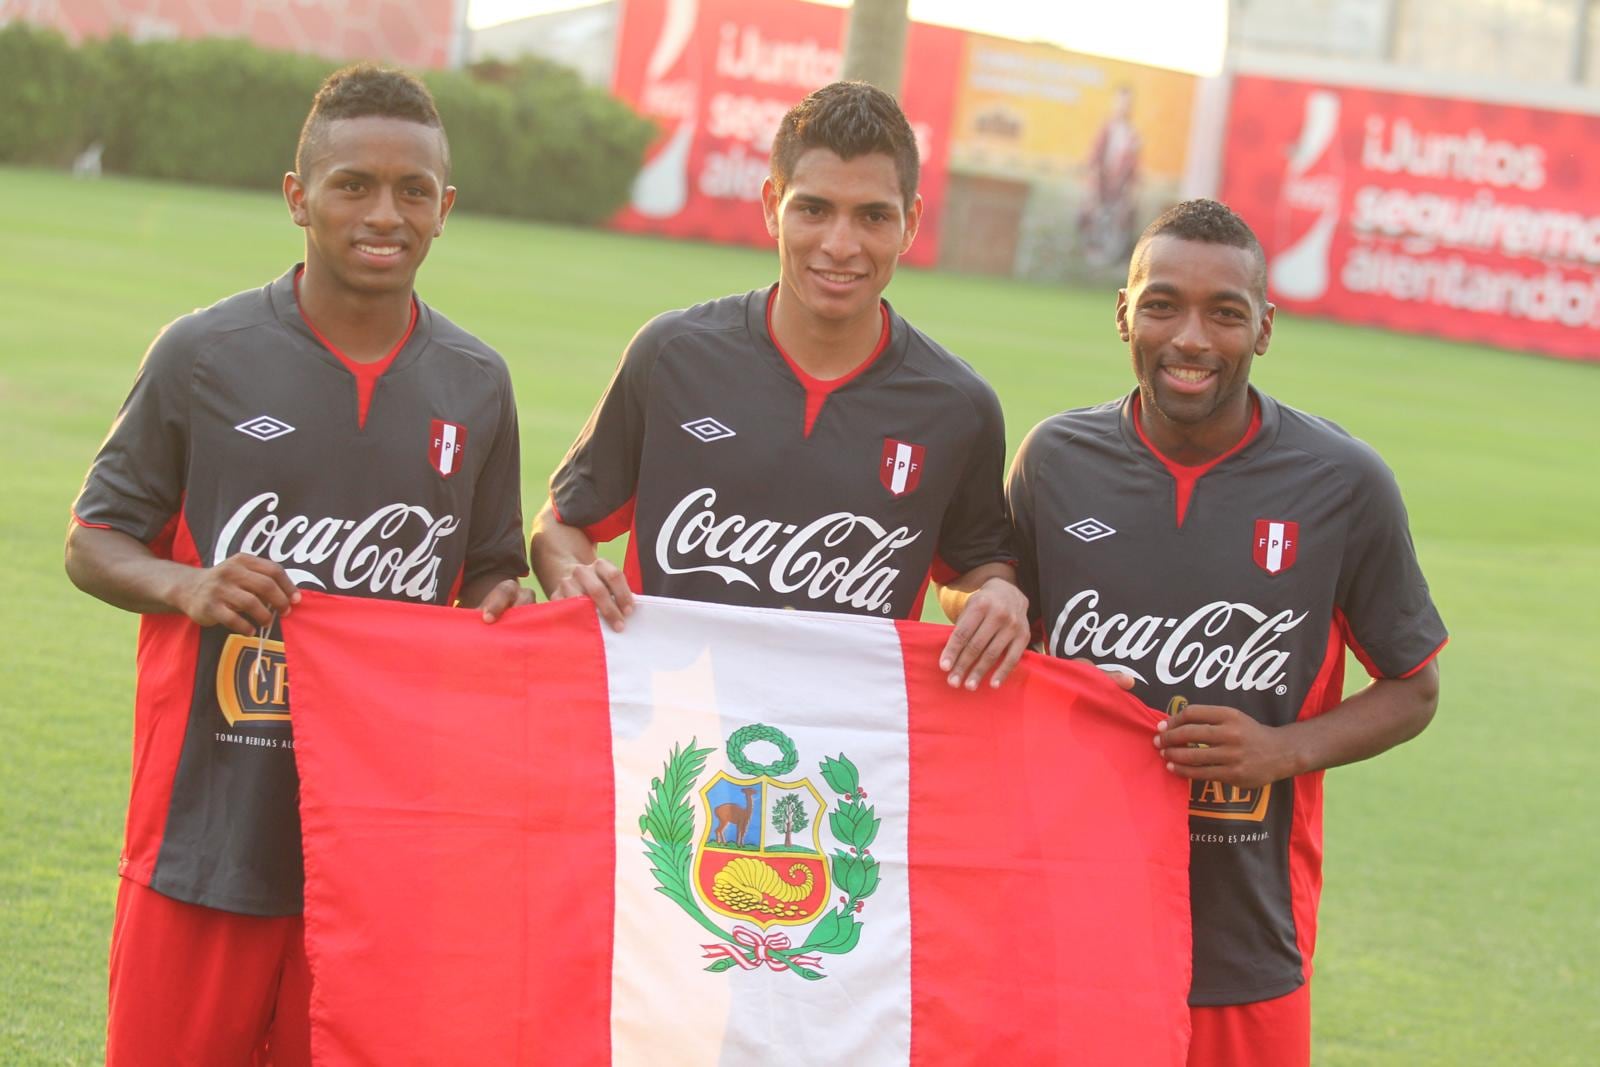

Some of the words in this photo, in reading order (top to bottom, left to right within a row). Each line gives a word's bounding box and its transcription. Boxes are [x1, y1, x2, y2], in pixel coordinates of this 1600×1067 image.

[655, 487, 922, 614] Coca-Cola
[215, 733, 243, 744] TOMAR
[245, 736, 277, 748] BEBIDAS
[1190, 833, 1224, 843] EXCESO
[1228, 834, 1237, 844] ES
